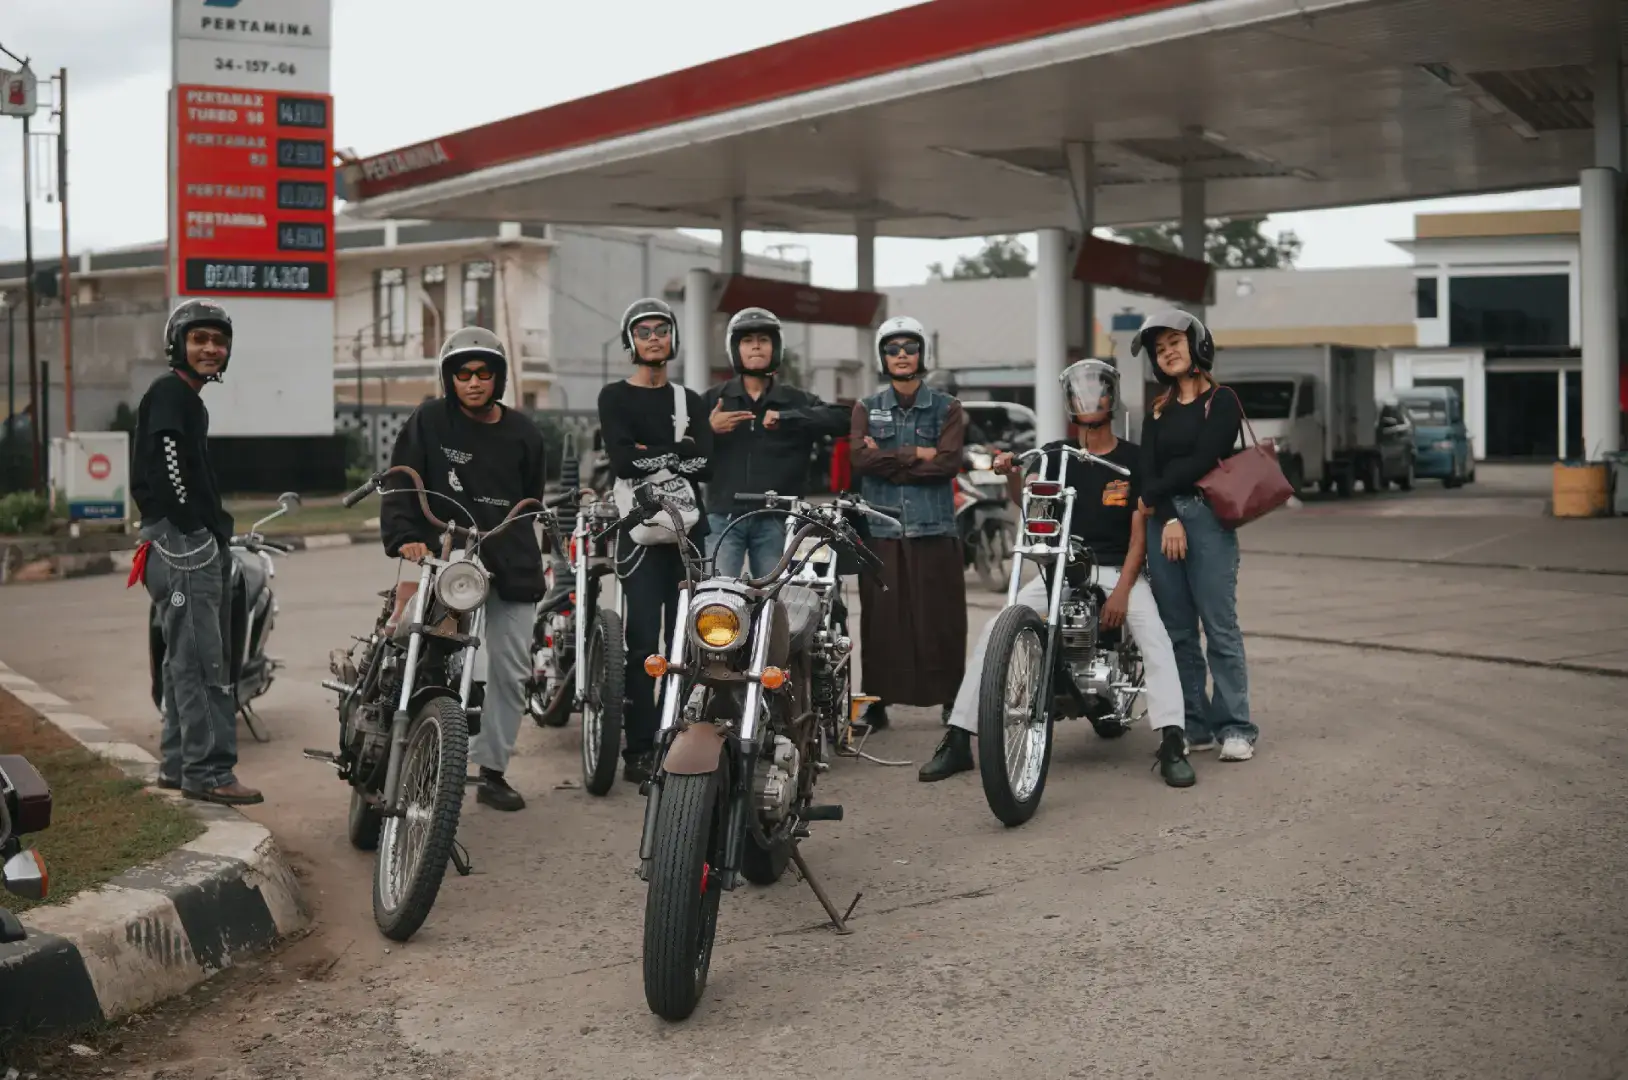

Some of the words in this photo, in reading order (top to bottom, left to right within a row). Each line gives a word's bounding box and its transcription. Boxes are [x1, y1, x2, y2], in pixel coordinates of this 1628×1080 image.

[201, 16, 312, 36] PERTAMINA
[214, 57, 297, 76] 34-157-06
[186, 90, 264, 107] PERTAMAX
[187, 107, 238, 122] TURBO
[186, 132, 268, 149] PERTAMAX
[362, 141, 448, 181] PERTAMINA
[186, 183, 267, 200] PERTALITE
[186, 210, 268, 228] PERTAMINA
